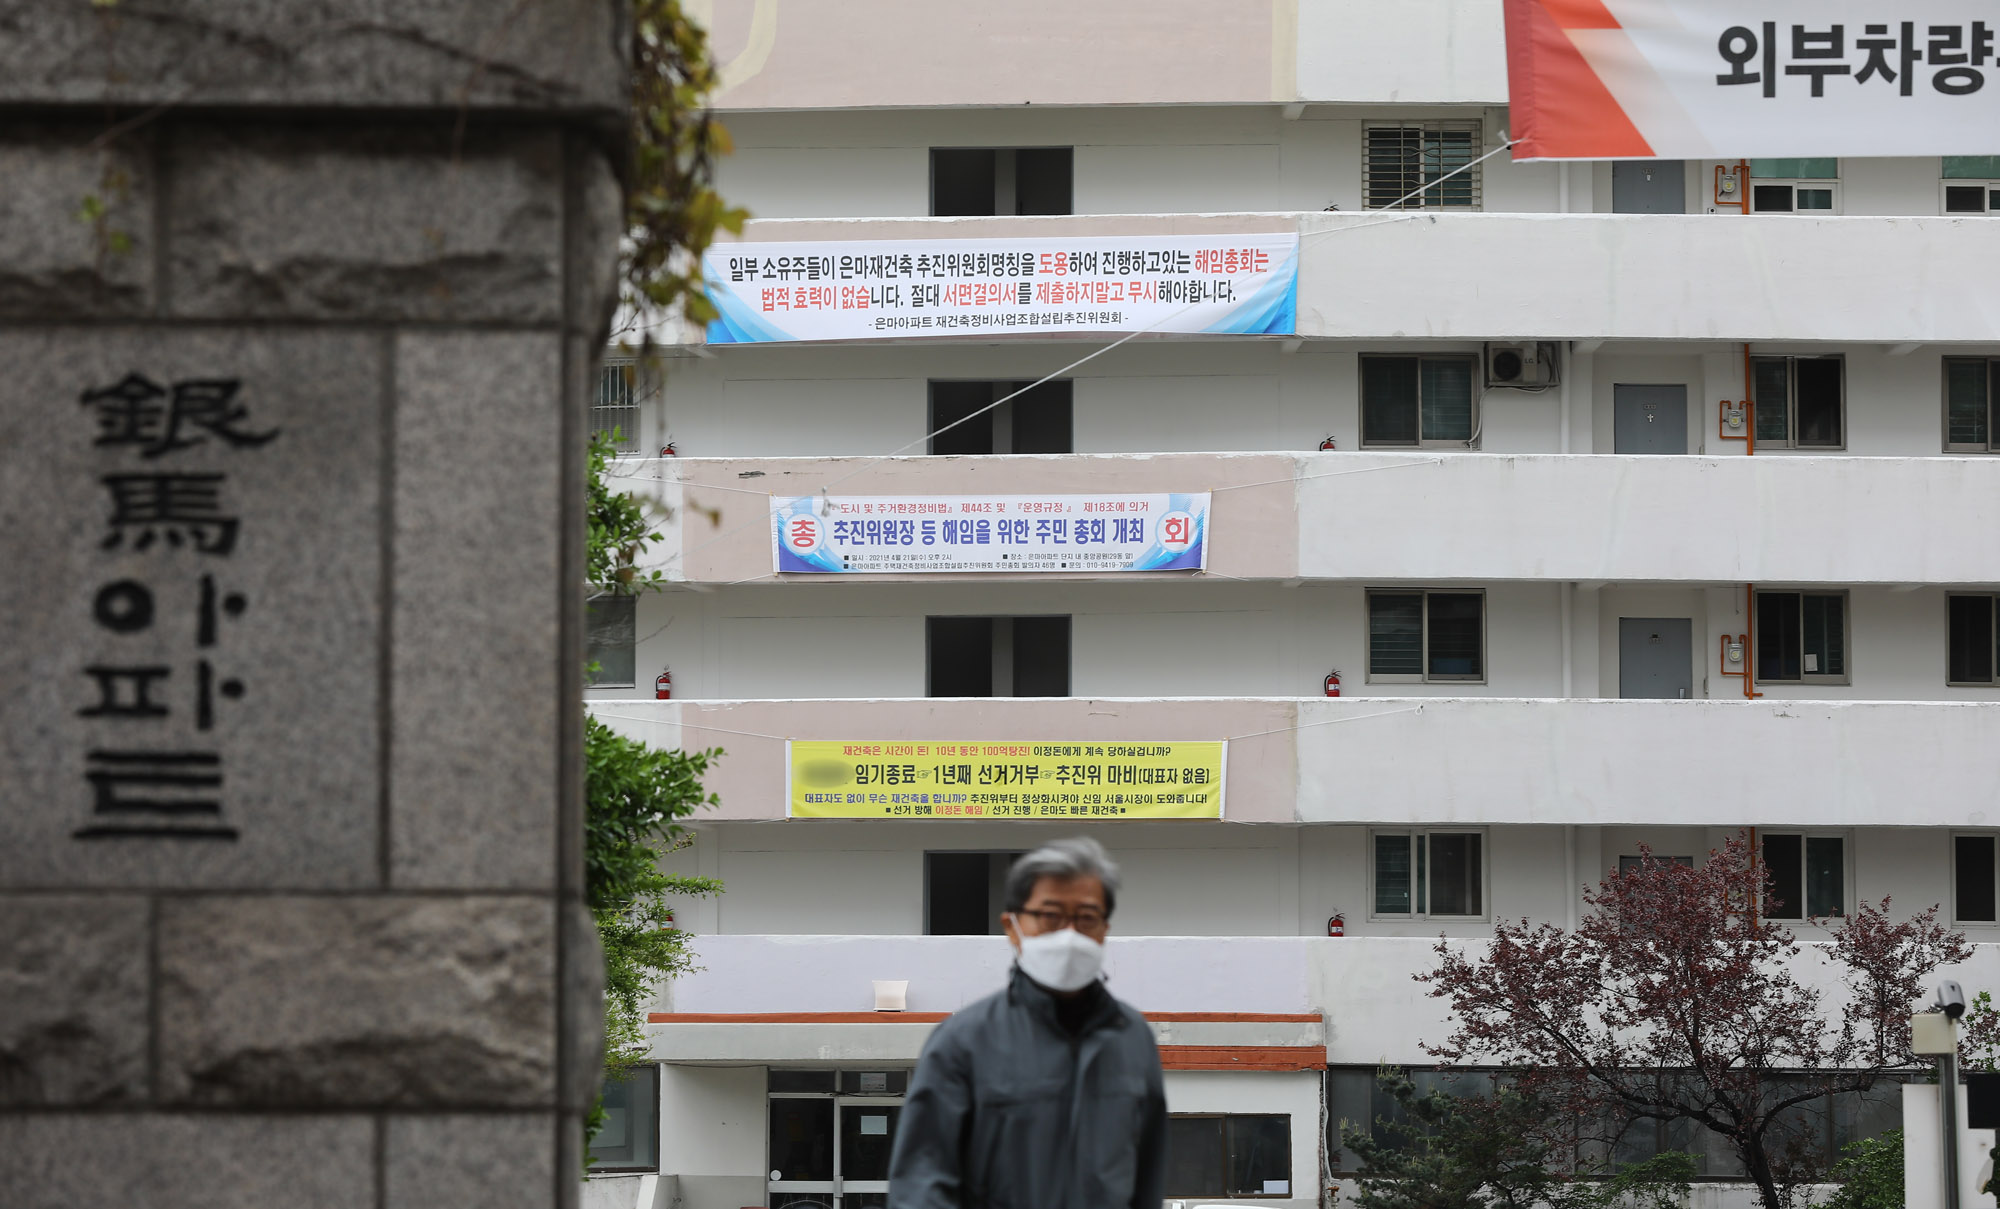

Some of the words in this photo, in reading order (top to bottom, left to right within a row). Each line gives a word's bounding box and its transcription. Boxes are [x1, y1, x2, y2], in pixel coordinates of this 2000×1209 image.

[1716, 21, 2000, 98] 외부차량
[730, 257, 758, 281] 일부
[763, 256, 834, 280] 소유주들이
[840, 254, 913, 279] 은마재건축
[917, 253, 1035, 278] 추진위원회명칭을
[1039, 251, 1097, 275] 도용하여
[1102, 250, 1191, 275] 진행하고있는
[1195, 248, 1269, 273] 해임총회는
[762, 287, 789, 311] 법적
[794, 286, 836, 310] 효력이
[842, 285, 903, 309] 없습니다.
[911, 284, 939, 307] 절대
[943, 282, 1032, 306] 서면결의서를
[1036, 281, 1124, 304] 제출하지말고
[1129, 280, 1236, 303] 무시해야합니다.
[875, 317, 932, 330] 은마아파트
[936, 312, 1121, 328] 재건축정비사업조합설립추진위원회
[864, 504, 872, 513] 및
[878, 504, 952, 513] 주거환경정비법』
[961, 503, 992, 513] 제44조
[997, 503, 1005, 513] 및
[1084, 502, 1125, 512] 제18조에
[1129, 502, 1148, 511] 의거
[792, 520, 816, 547] 총
[834, 520, 915, 545] 추진위원장
[921, 520, 936, 545] 등
[943, 520, 990, 544] 해임을
[997, 519, 1030, 544] 위한
[1036, 519, 1067, 544] 주민
[1074, 519, 1105, 544] 총회
[1113, 518, 1143, 543] 개최
[1165, 518, 1189, 544] 회
[851, 563, 881, 571] 은마아파트
[72, 371, 281, 842] 銀馬아파트
[843, 746, 881, 756] 재건축은
[885, 746, 913, 756] 시간이
[917, 746, 929, 755] 돈!
[936, 746, 957, 756] 10년
[960, 746, 979, 756] 동안
[982, 745, 1030, 756] 100억탕진!
[1034, 746, 1081, 756] 이정돈에게
[1085, 747, 1103, 756] 계속
[1108, 747, 1170, 756] 당하실겁니까?
[856, 765, 915, 785] 임기종료
[933, 765, 971, 785] 1년째
[978, 765, 1039, 785] 선거거부
[1056, 765, 1101, 785] 추진위
[805, 794, 842, 803] 대표자도
[847, 794, 864, 803] 없이
[869, 794, 887, 803] 무슨
[891, 794, 929, 803] 재건축을
[933, 794, 966, 803] 합니까?
[971, 794, 1017, 803] 추진위부터
[1022, 794, 1079, 804] 정상화시켜야
[1083, 794, 1101, 804] 신임
[1105, 794, 1152, 804] 서울시장이
[1156, 794, 1207, 804] 도와줍니다!
[894, 806, 910, 816] 선거
[915, 806, 931, 815] 방해
[935, 806, 961, 815] 이정돈
[965, 806, 982, 815] 해임
[993, 806, 1009, 815] 선거
[1013, 806, 1030, 815] 진행
[1041, 806, 1067, 815] 은마도
[1071, 806, 1088, 815] 빠른
[1091, 806, 1118, 815] 재건축
